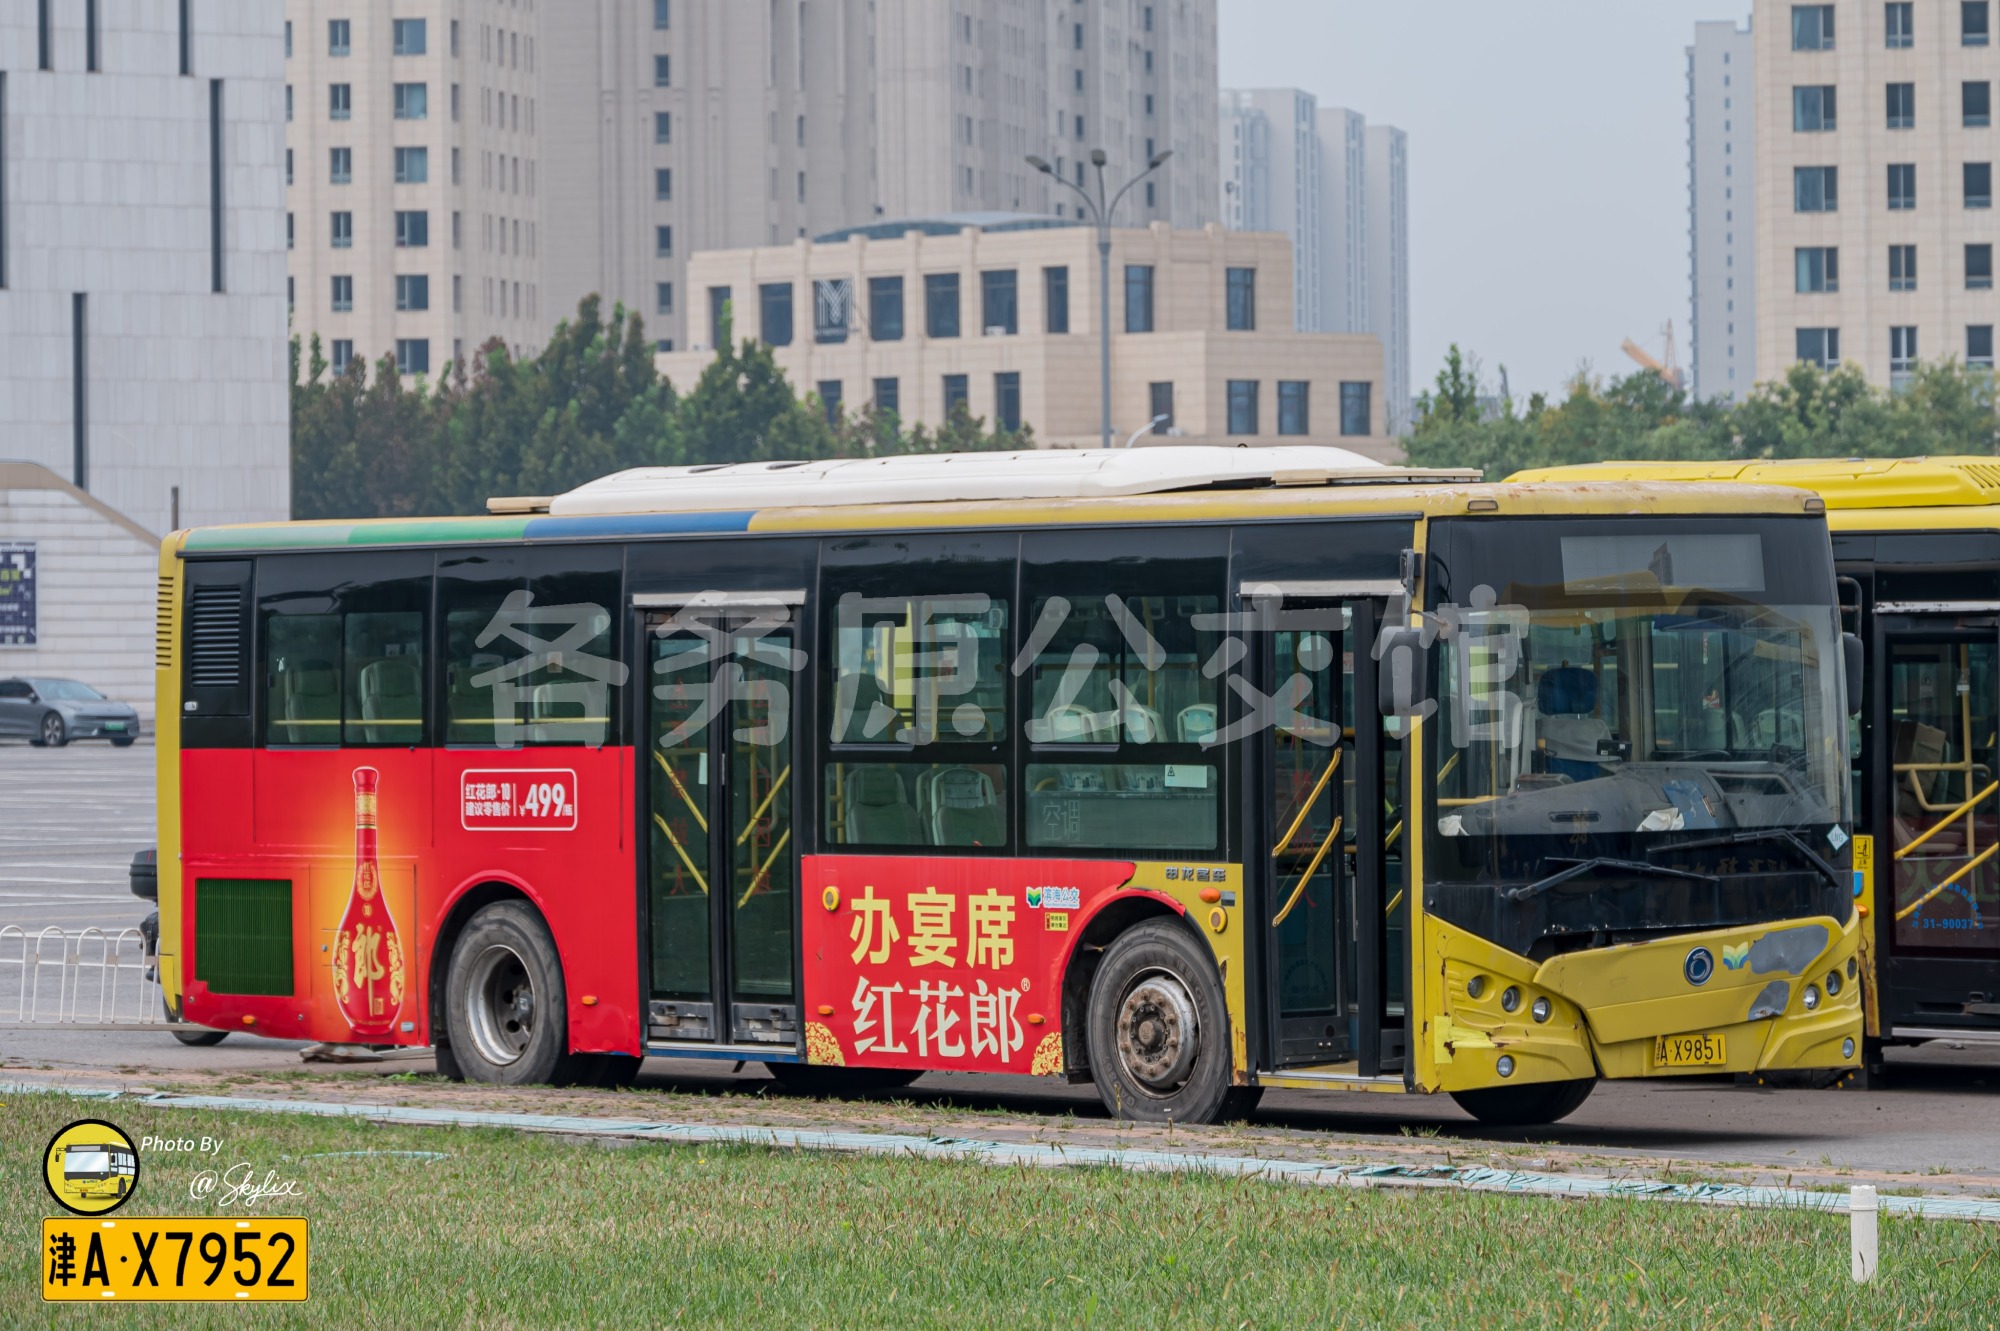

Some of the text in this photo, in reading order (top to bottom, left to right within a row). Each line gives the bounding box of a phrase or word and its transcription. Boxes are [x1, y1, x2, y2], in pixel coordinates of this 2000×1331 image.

[465, 801, 511, 817] 建议零售价
[1831, 832, 1844, 842] LNG
[1166, 866, 1226, 882] 申龙客车
[1043, 887, 1079, 902] 滨海公交
[850, 886, 1016, 970] 办宴席
[1923, 918, 1974, 929] 31-90037
